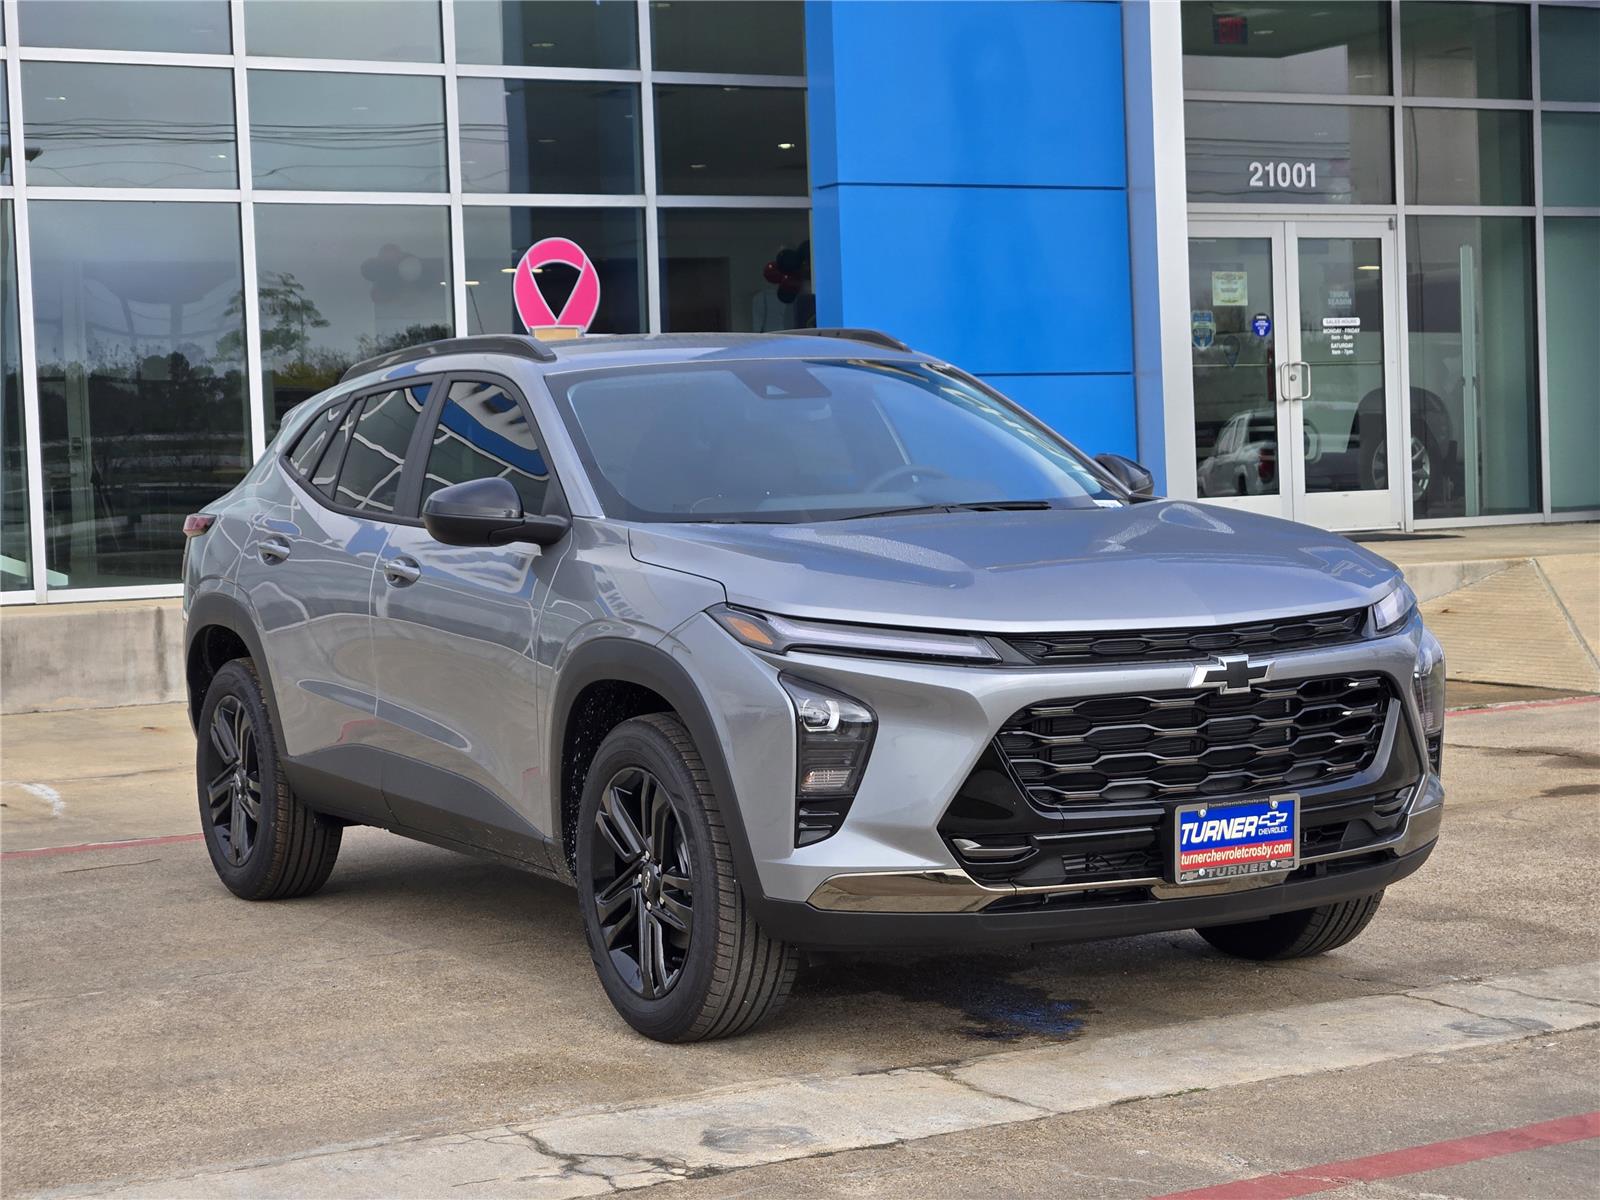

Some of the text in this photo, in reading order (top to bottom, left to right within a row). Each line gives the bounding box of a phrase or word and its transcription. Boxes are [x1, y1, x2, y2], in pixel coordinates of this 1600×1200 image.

[1249, 161, 1316, 188] 21001
[1181, 816, 1259, 845] TURNER
[1259, 825, 1288, 836] CHEVROLET
[1181, 843, 1292, 865] turnerchevroletcrosby.com
[1207, 863, 1268, 878] TURNER
